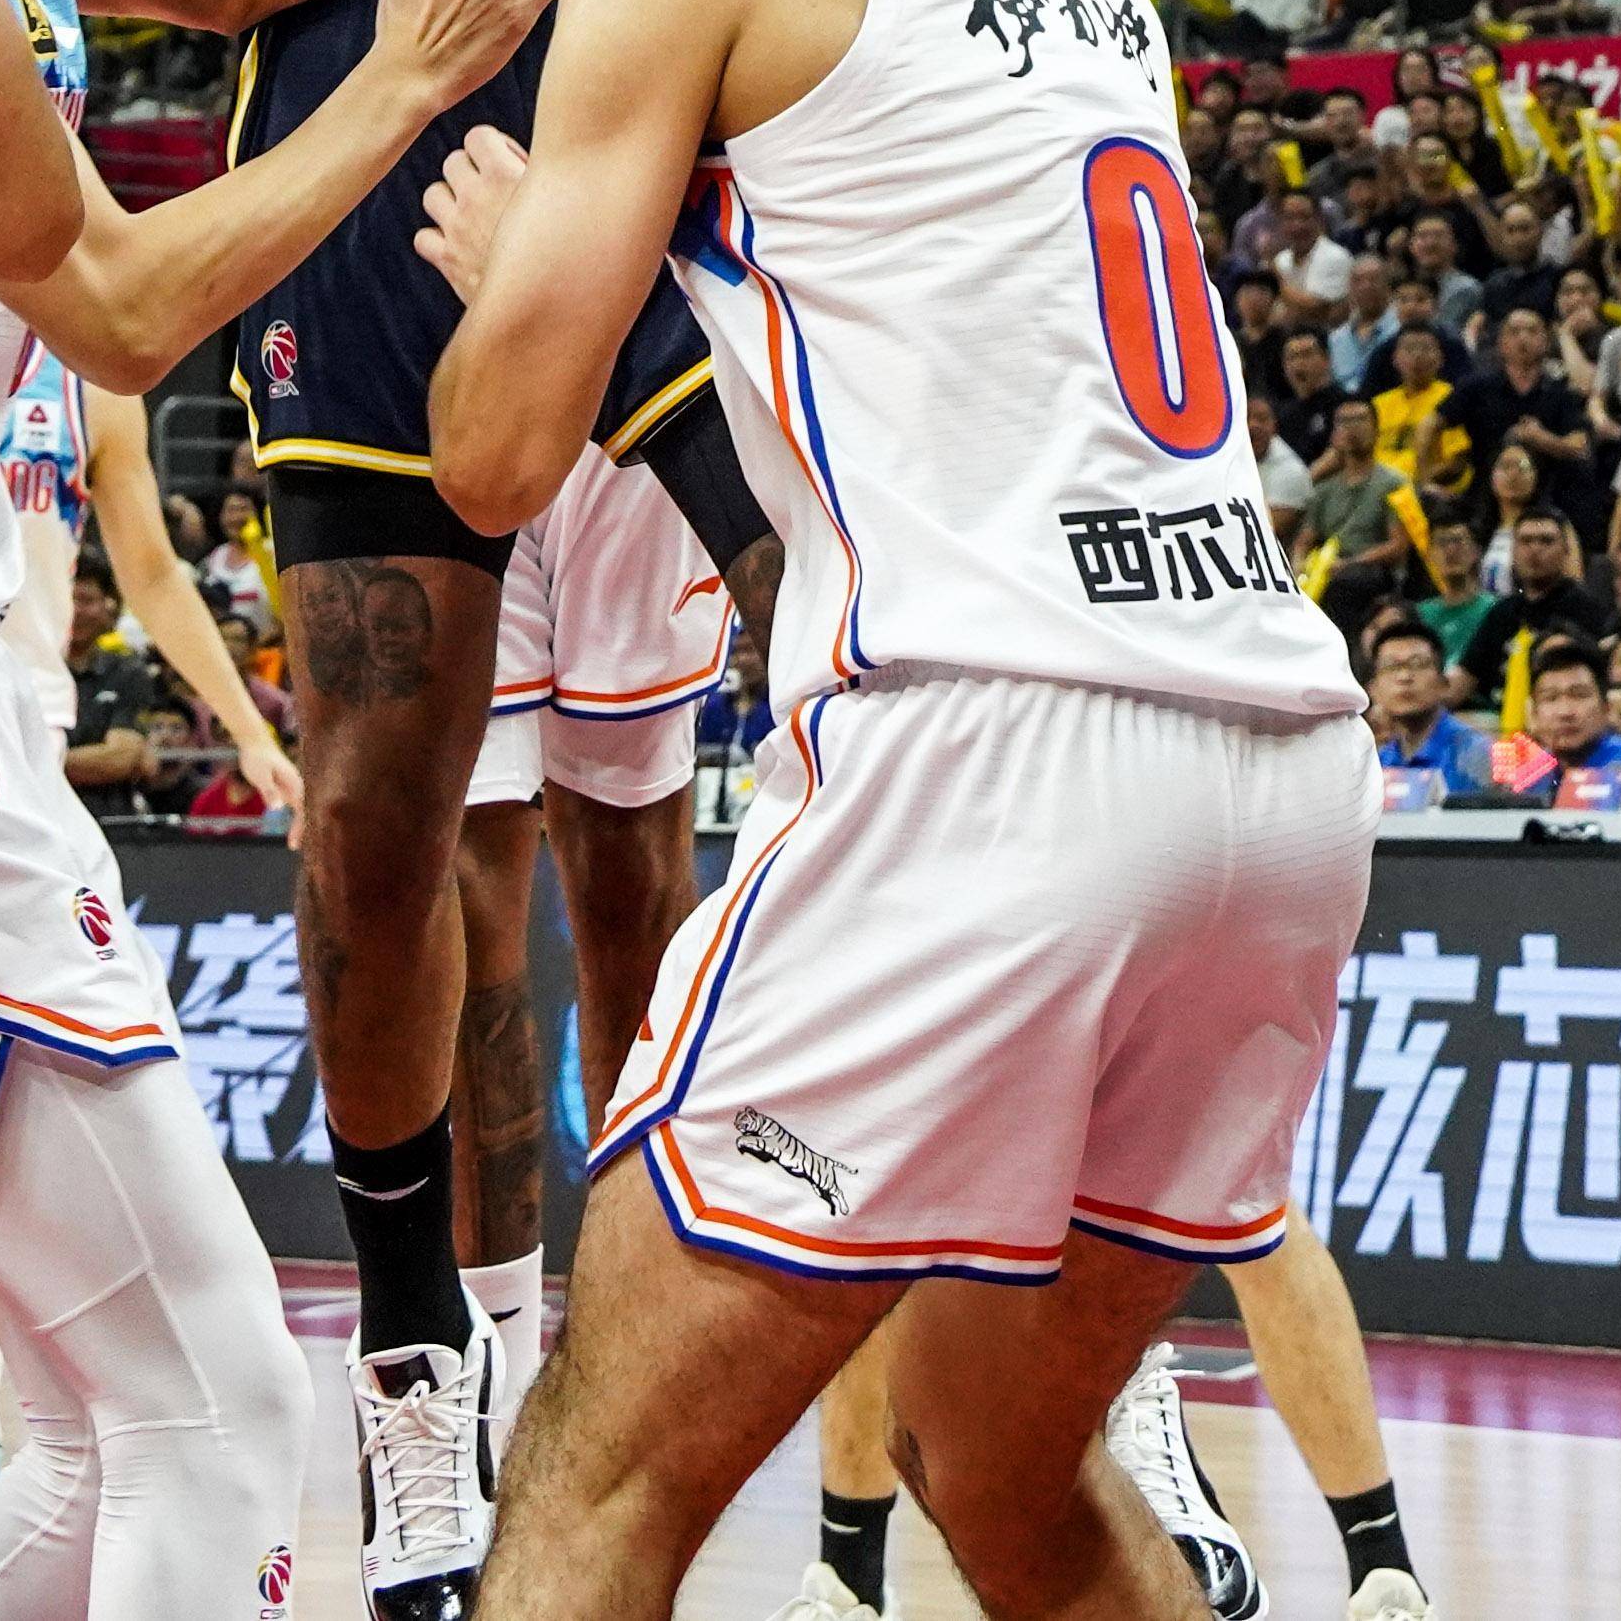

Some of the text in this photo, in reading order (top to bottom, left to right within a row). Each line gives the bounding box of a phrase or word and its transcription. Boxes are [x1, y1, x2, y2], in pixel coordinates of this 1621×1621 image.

[1082, 136, 1234, 460] 0
[1059, 496, 1301, 604] 西尔扎
